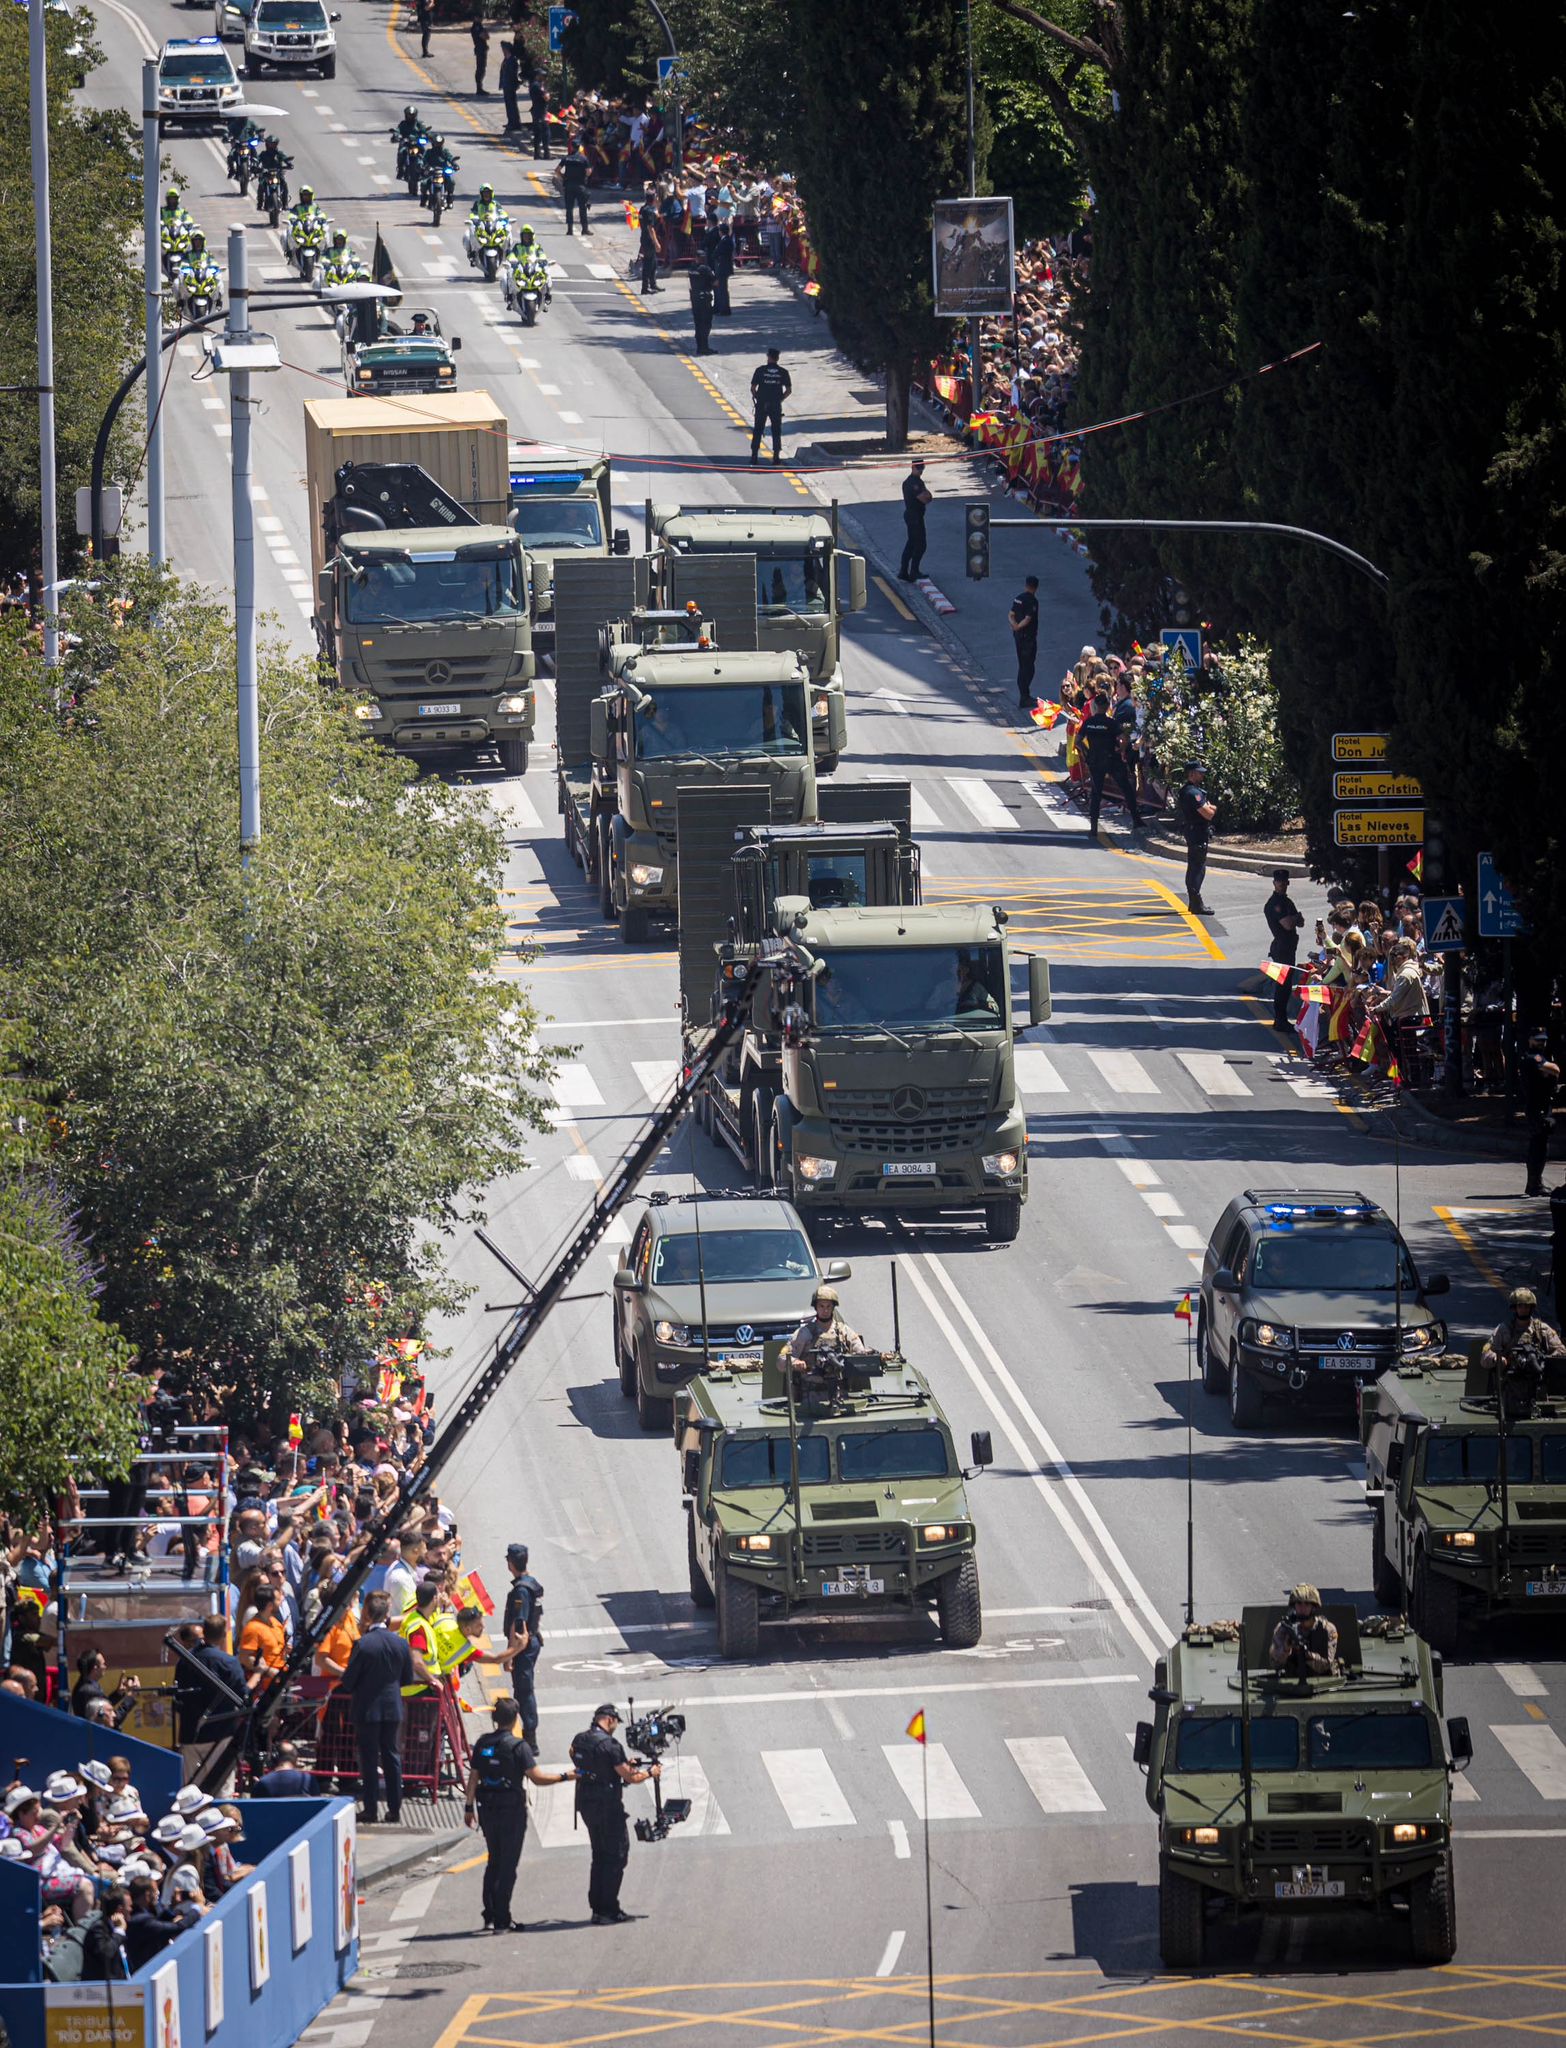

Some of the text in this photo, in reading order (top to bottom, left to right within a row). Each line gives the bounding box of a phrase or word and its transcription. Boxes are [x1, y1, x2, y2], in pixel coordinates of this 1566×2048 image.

[438, 505, 457, 523] HIAB
[1337, 737, 1360, 745] Hotel
[1337, 746, 1384, 757] Don Ju
[1339, 776, 1362, 784] Hotel
[1340, 784, 1373, 796] Reina
[1340, 813, 1362, 821] Hotel
[1340, 820, 1410, 832] Las Nieves
[1341, 832, 1417, 844] Sacromonte
[888, 1163, 932, 1174] EA 9084 3
[1325, 1357, 1372, 1369] EA 9365 3
[828, 1583, 840, 1593] EA
[873, 1582, 879, 1592] 3
[1532, 1583, 1544, 1594] EA
[1282, 1884, 1296, 1896] EA
[1331, 1883, 1339, 1895] 3
